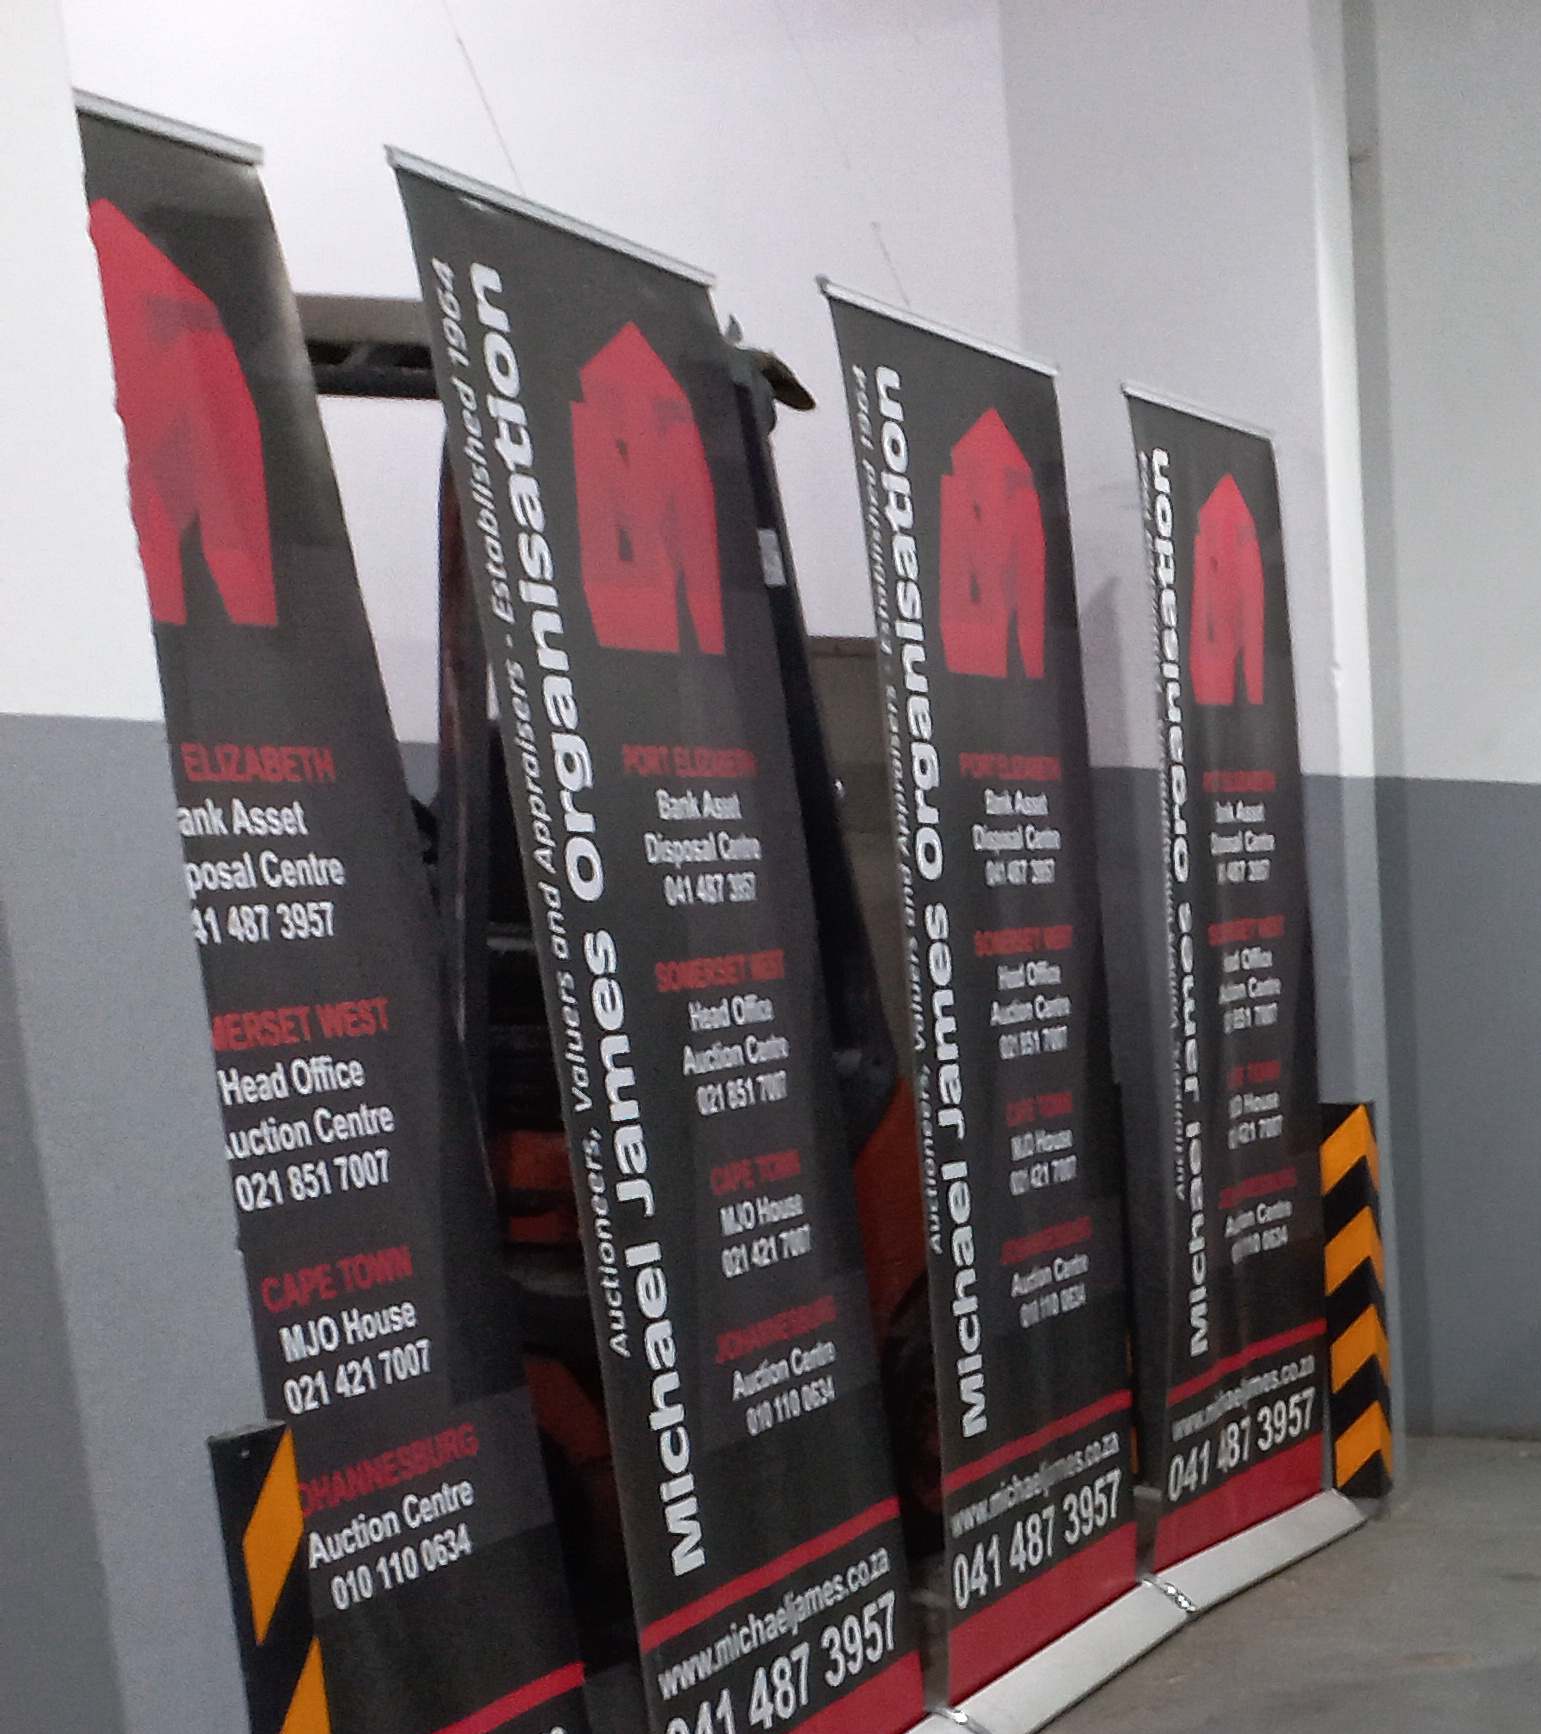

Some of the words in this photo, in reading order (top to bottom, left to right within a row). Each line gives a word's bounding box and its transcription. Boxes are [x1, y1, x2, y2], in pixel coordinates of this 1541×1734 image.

[431, 257, 470, 367] 1964
[450, 376, 514, 625] Established
[468, 262, 606, 902] Organisation
[875, 366, 943, 881] Organisation
[176, 798, 228, 837] ank
[231, 798, 309, 837] Asset
[180, 741, 337, 784] ELIZABETH
[505, 659, 556, 874] Appraisers
[183, 851, 257, 899] posal
[259, 850, 347, 888] Centre
[227, 904, 271, 943] 487
[275, 901, 335, 940] 3957
[536, 881, 570, 960] and
[315, 996, 391, 1038] WEST
[556, 971, 594, 1113] Valuers
[583, 929, 655, 1218] James
[924, 903, 965, 1140] James
[217, 1061, 289, 1105] Head
[290, 1054, 366, 1095] Office
[313, 1103, 395, 1143] Centre
[235, 1169, 284, 1212] 021
[286, 1159, 332, 1200] 851
[333, 1148, 391, 1191] 7007
[261, 1263, 337, 1313] CAPE
[339, 1245, 414, 1292] TOWN
[580, 1128, 631, 1358] Auctioneers,
[1185, 1121, 1209, 1358] Michael
[279, 1315, 340, 1363] MJO
[341, 1301, 417, 1345] House
[941, 1161, 987, 1438] Michael
[283, 1370, 331, 1415] 021
[334, 1355, 378, 1398] 421
[377, 1338, 432, 1384] 7007
[624, 1241, 706, 1577] Michael
[1168, 1439, 1210, 1502] 041
[1257, 1386, 1316, 1452] 3957
[308, 1509, 401, 1569] Auction
[402, 1480, 475, 1529] Centre
[330, 1565, 374, 1610] 010
[376, 1546, 421, 1589] 110
[953, 1534, 1002, 1610] 041
[1009, 1505, 1056, 1573] 487
[1063, 1467, 1122, 1545] 3957
[658, 1547, 890, 1701] www.michaeljames.co.za
[749, 1641, 810, 1729] 487
[821, 1590, 895, 1687] 3957
